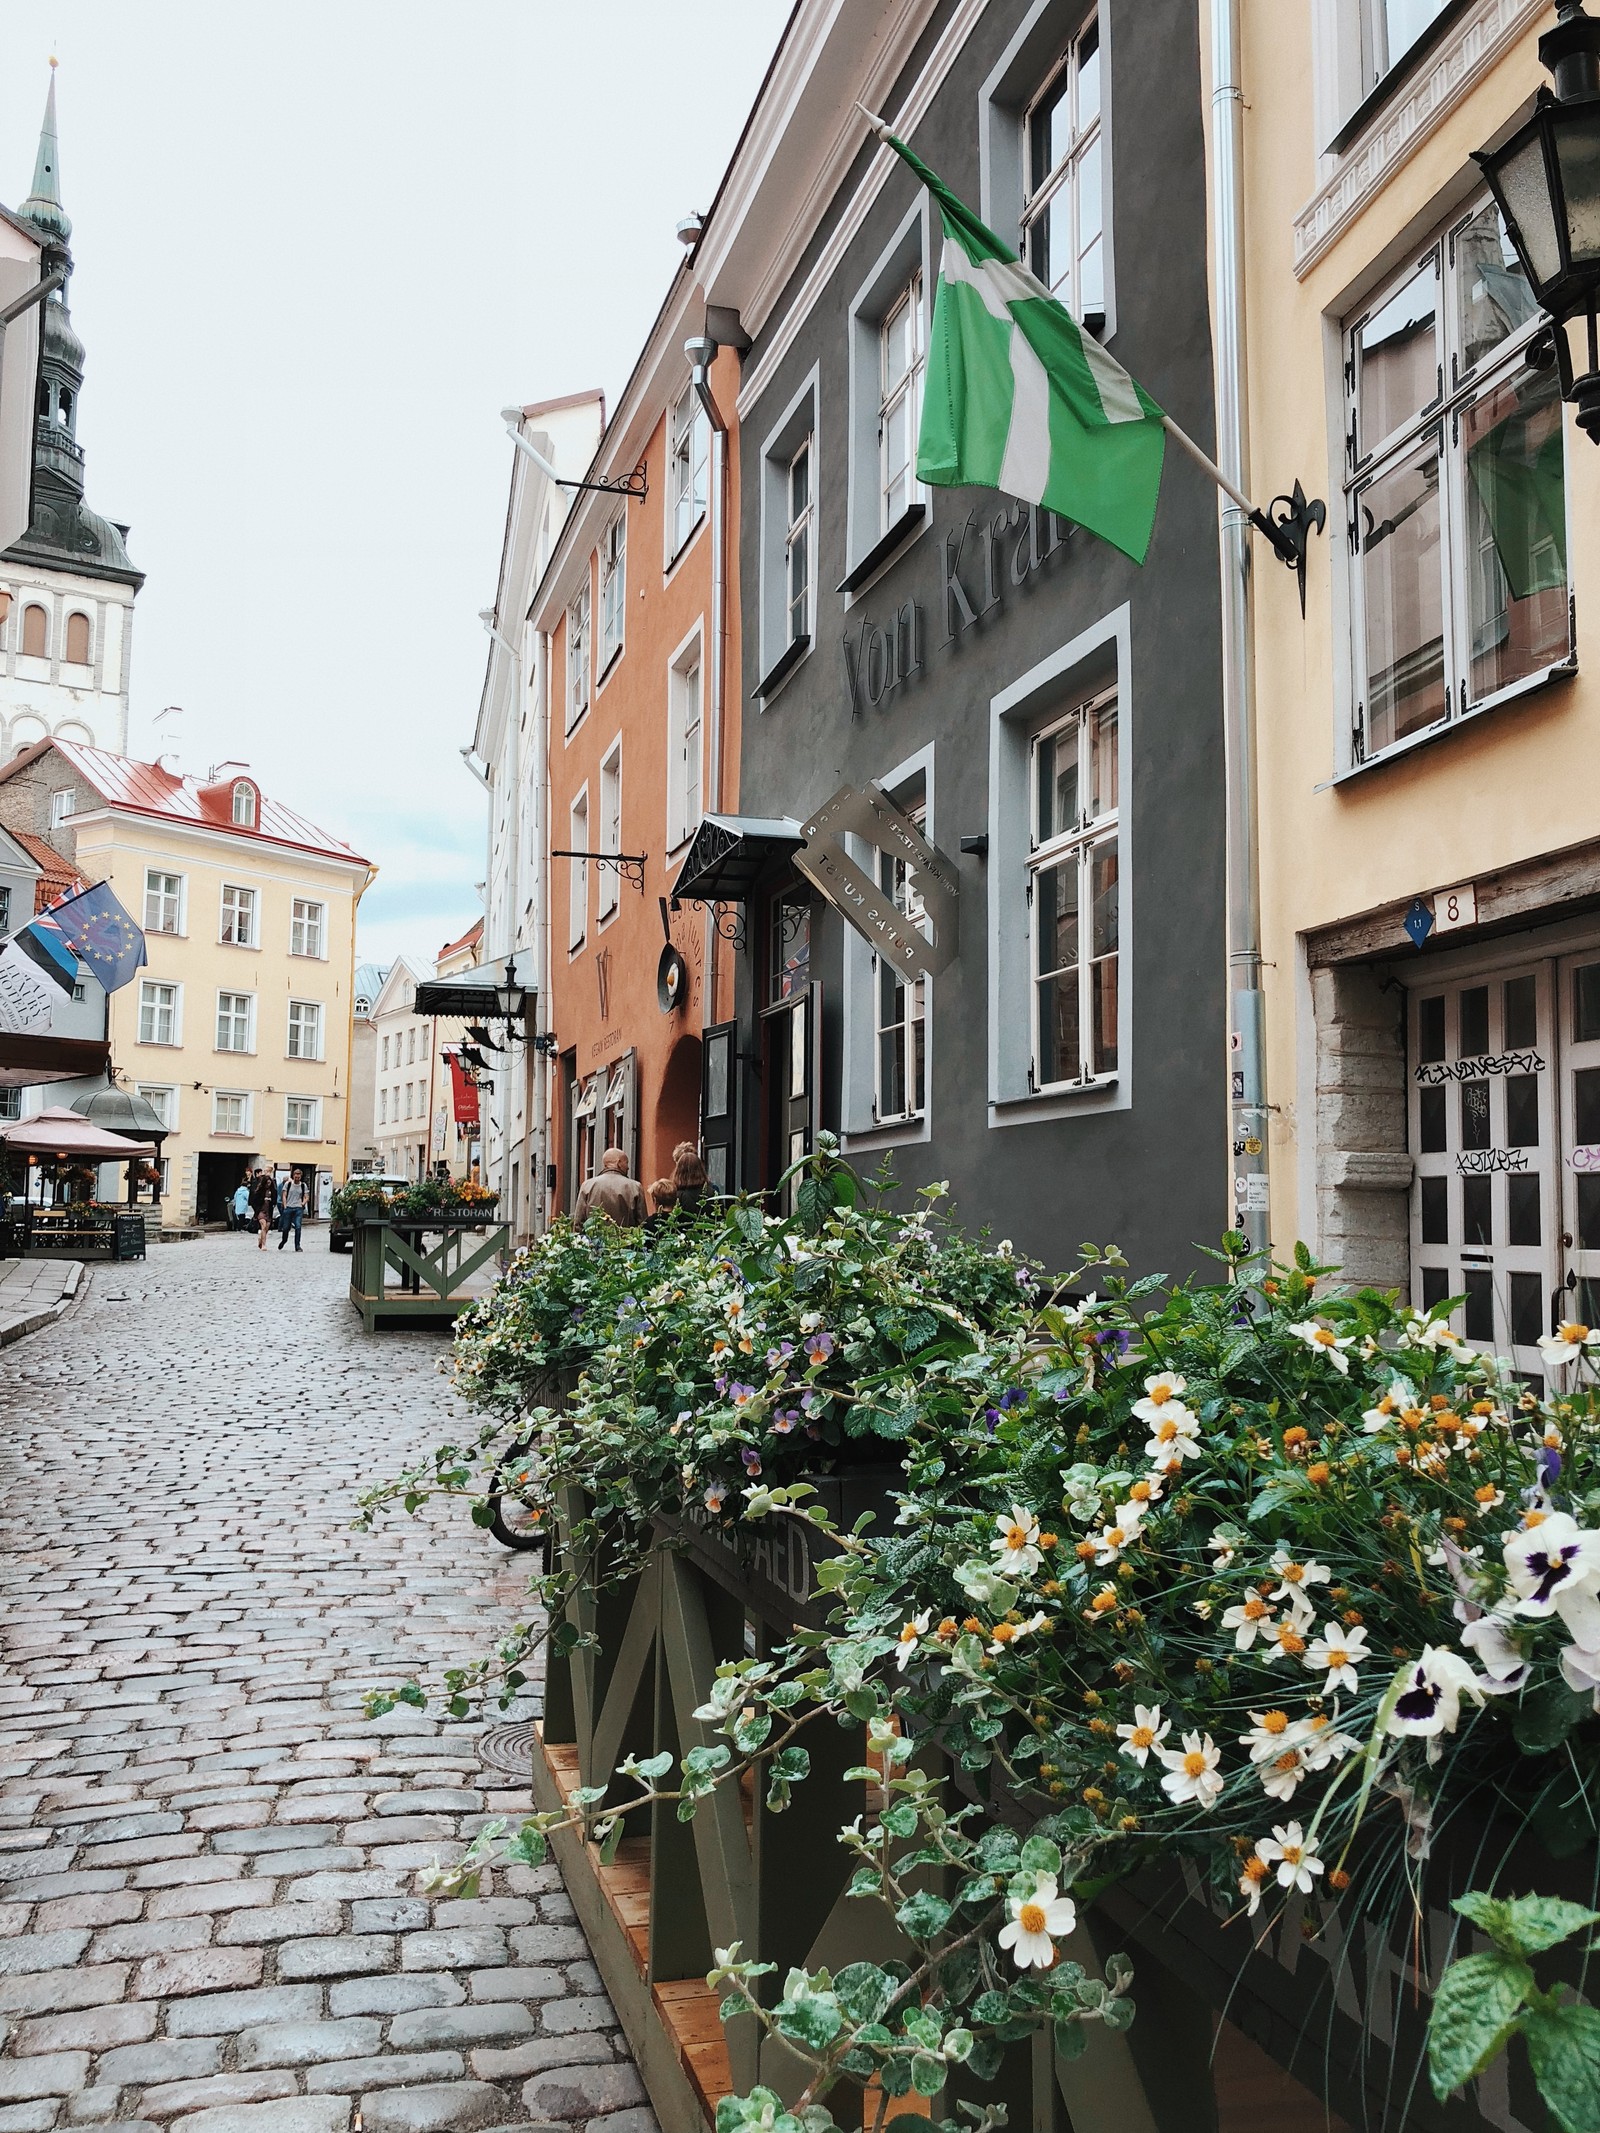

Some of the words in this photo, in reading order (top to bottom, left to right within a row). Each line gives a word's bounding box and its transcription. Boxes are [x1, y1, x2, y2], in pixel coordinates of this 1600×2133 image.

[842, 597, 924, 723] Von
[1447, 895, 1460, 922] 8
[0, 969, 31, 1026] HOTELS
[6, 965, 42, 1019] LUXURY
[433, 1207, 492, 1217] RESTORAN
